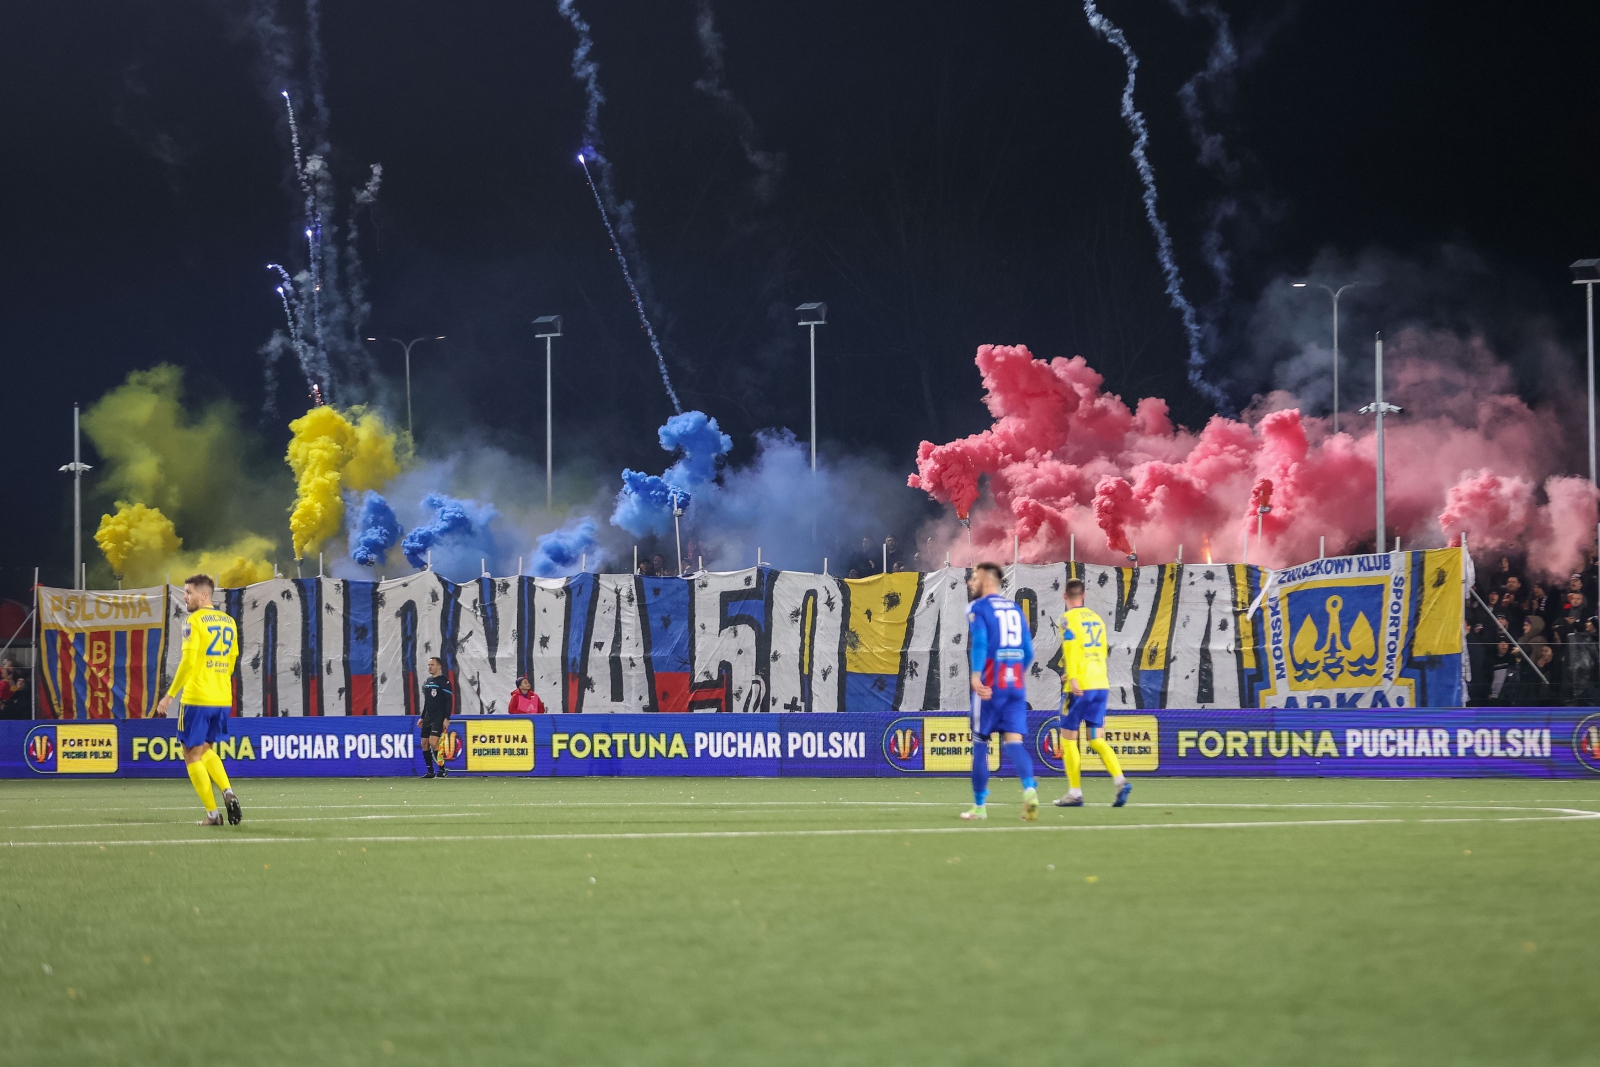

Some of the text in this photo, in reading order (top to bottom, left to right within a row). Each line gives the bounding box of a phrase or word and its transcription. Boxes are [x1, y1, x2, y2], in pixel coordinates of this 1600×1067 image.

[1357, 553, 1391, 573] KLUB
[50, 593, 152, 622] POLONIA
[206, 625, 234, 656] 29
[994, 609, 1022, 647] 19
[1081, 621, 1102, 647] 32
[1268, 595, 1287, 680] MORSKI
[1382, 575, 1405, 682] SPORTOWY
[62, 739, 112, 747] FORTUNA
[132, 733, 414, 761] FORNA PUCHAR POLSKI
[472, 735, 528, 744] FORTUNA
[472, 748, 528, 756] PUCHAR POLSKI
[552, 731, 866, 758] FORTUNA PUCHAR POLSKI
[931, 746, 962, 755] PUCHAR
[1121, 745, 1152, 755] POLSKI
[1177, 728, 1551, 757] FORTUNA PUCHAR POLSKI
[62, 751, 112, 759] PUCHAR POLSKI
